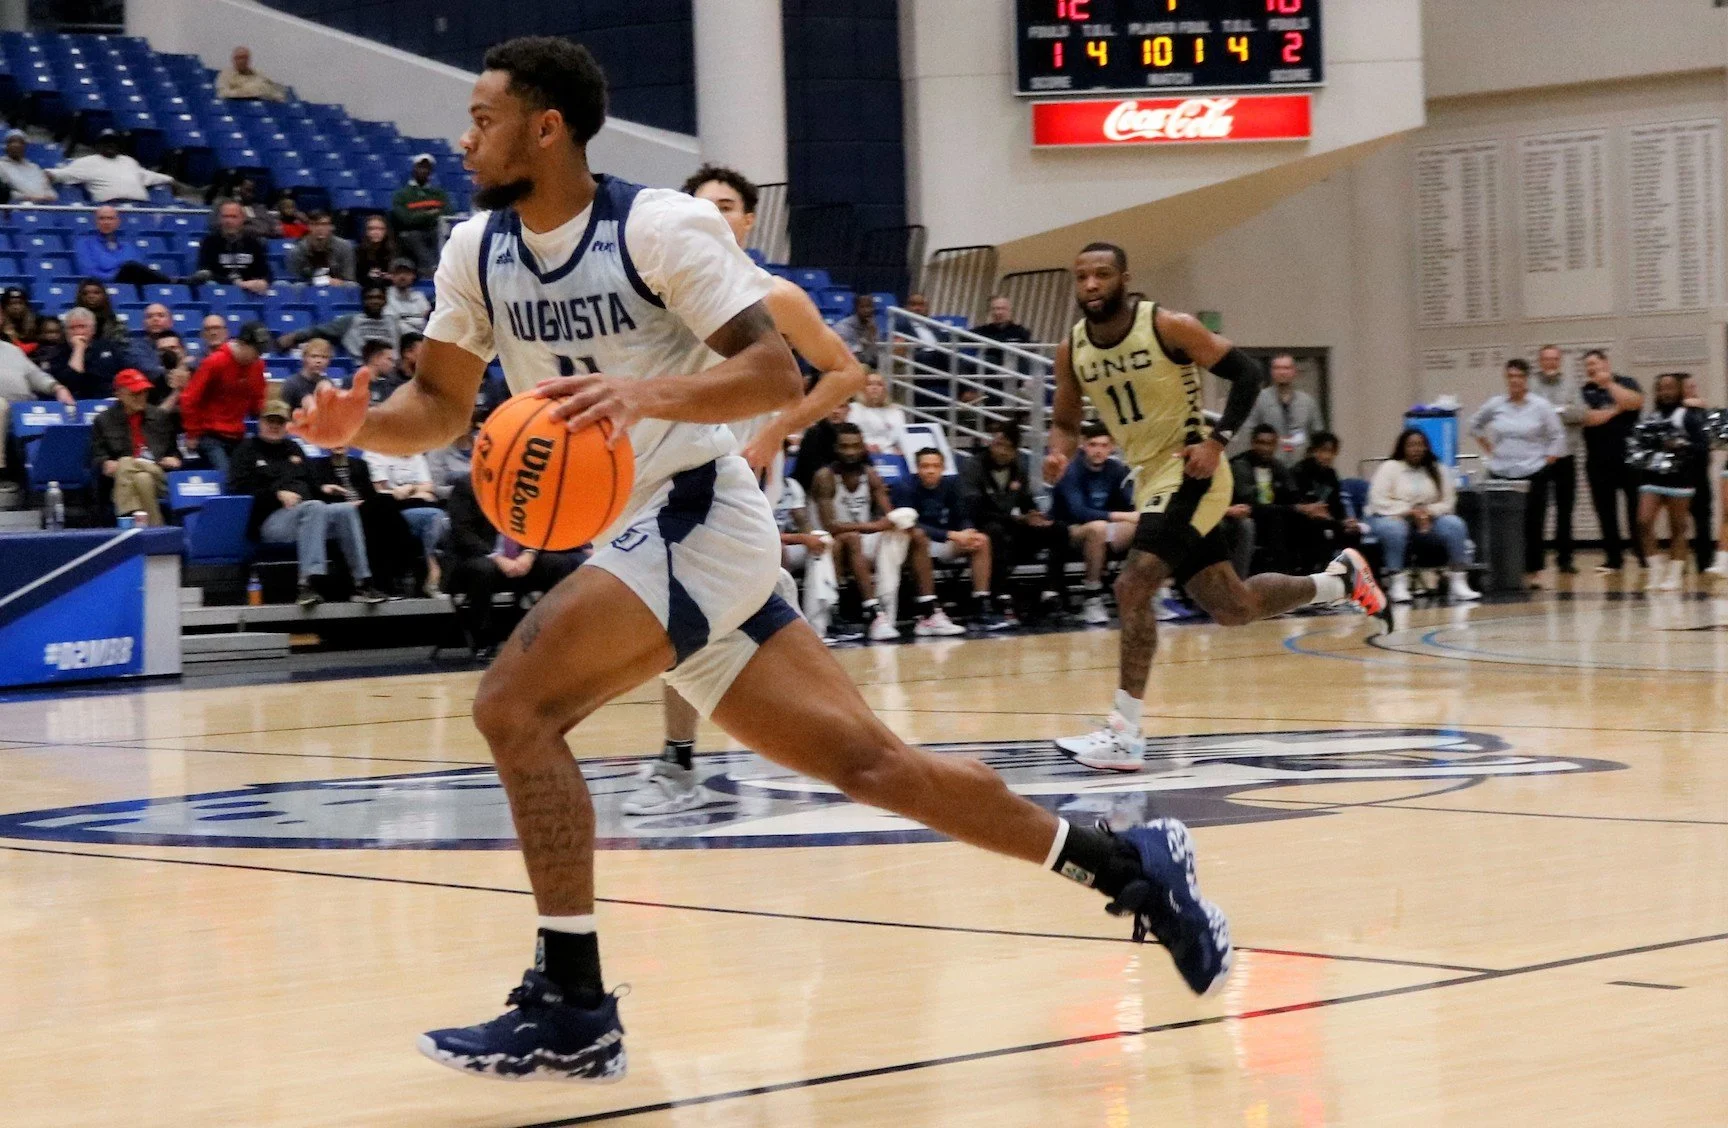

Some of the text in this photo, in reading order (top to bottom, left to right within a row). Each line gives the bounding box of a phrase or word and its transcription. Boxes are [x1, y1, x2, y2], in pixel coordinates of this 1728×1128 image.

[1053, 42, 1063, 68] 1
[1087, 41, 1108, 66] 4
[1143, 36, 1173, 66] 10
[1194, 38, 1204, 63] 1
[1228, 36, 1249, 62] 4
[1282, 32, 1303, 62] 2
[1106, 380, 1144, 425] 11
[511, 437, 554, 535] Wilson
